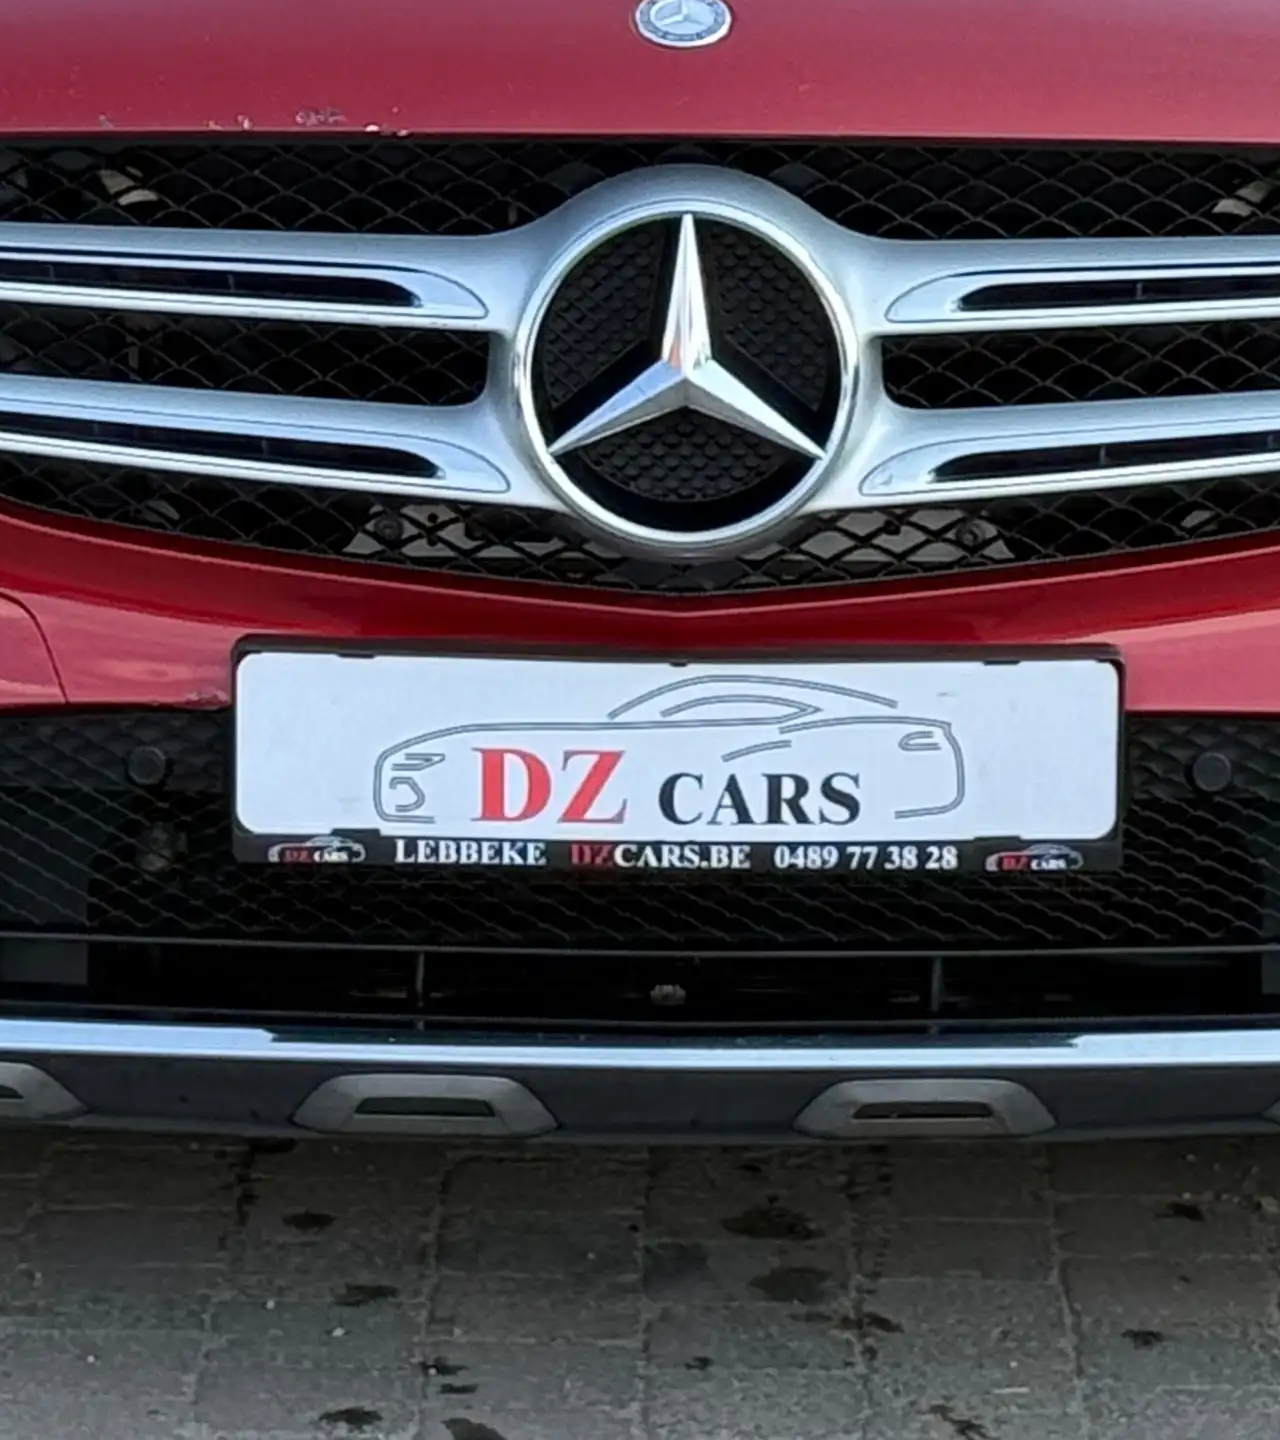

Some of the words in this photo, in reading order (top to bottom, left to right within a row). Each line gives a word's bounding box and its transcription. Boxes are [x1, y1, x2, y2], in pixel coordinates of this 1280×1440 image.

[470, 747, 628, 823] DZ
[658, 772, 861, 826] CARS
[394, 838, 548, 867] LEBBEKE
[570, 842, 752, 870] DZCARS.BE
[774, 844, 840, 870] 0489
[846, 844, 879, 871] 77
[883, 844, 919, 871] 38
[924, 845, 959, 872] 28
